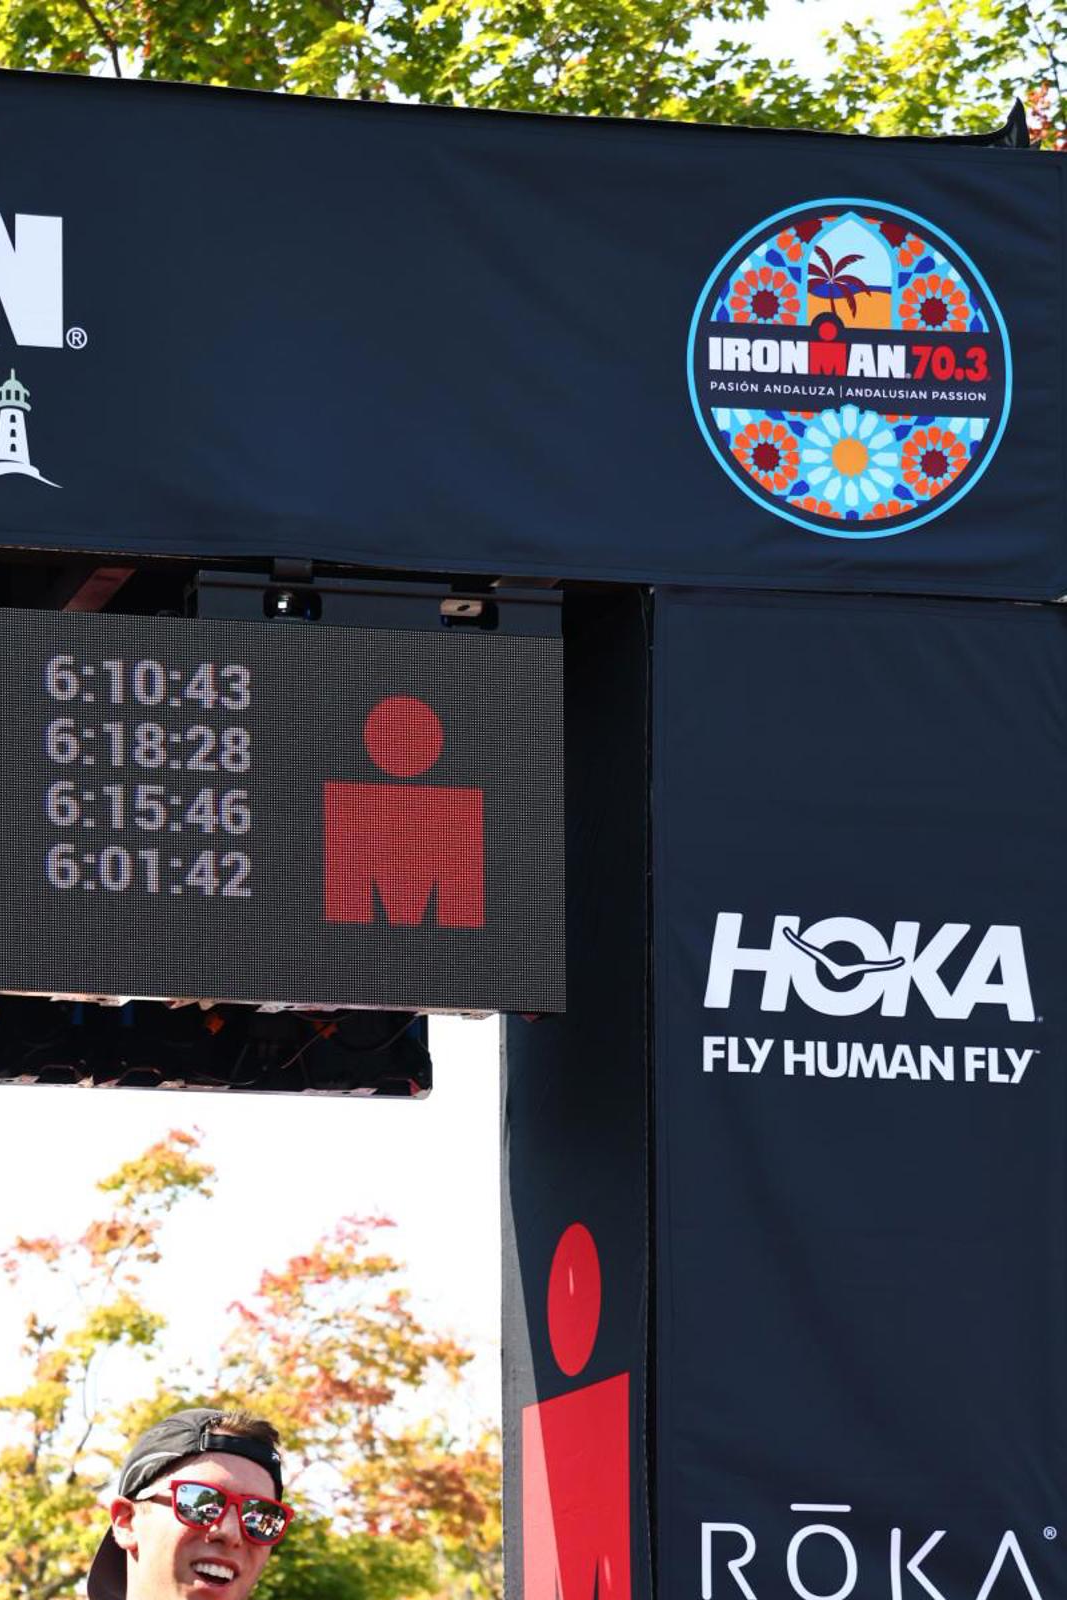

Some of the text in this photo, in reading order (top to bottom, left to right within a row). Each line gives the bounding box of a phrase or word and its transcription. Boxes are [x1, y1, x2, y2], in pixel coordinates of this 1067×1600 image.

[709, 337, 988, 382] IRONMAN 70.3
[710, 380, 987, 402] PASIÓN ANDALUZA ANDALUSIAN PASSION
[45, 656, 251, 710] 6:10:43
[45, 718, 251, 773] 6:18:28
[45, 780, 251, 834] 6:15:46
[45, 843, 251, 897] 6:01:42
[704, 912, 1035, 1022] HOKA
[703, 1036, 1034, 1084] FLY HUMAN FLY
